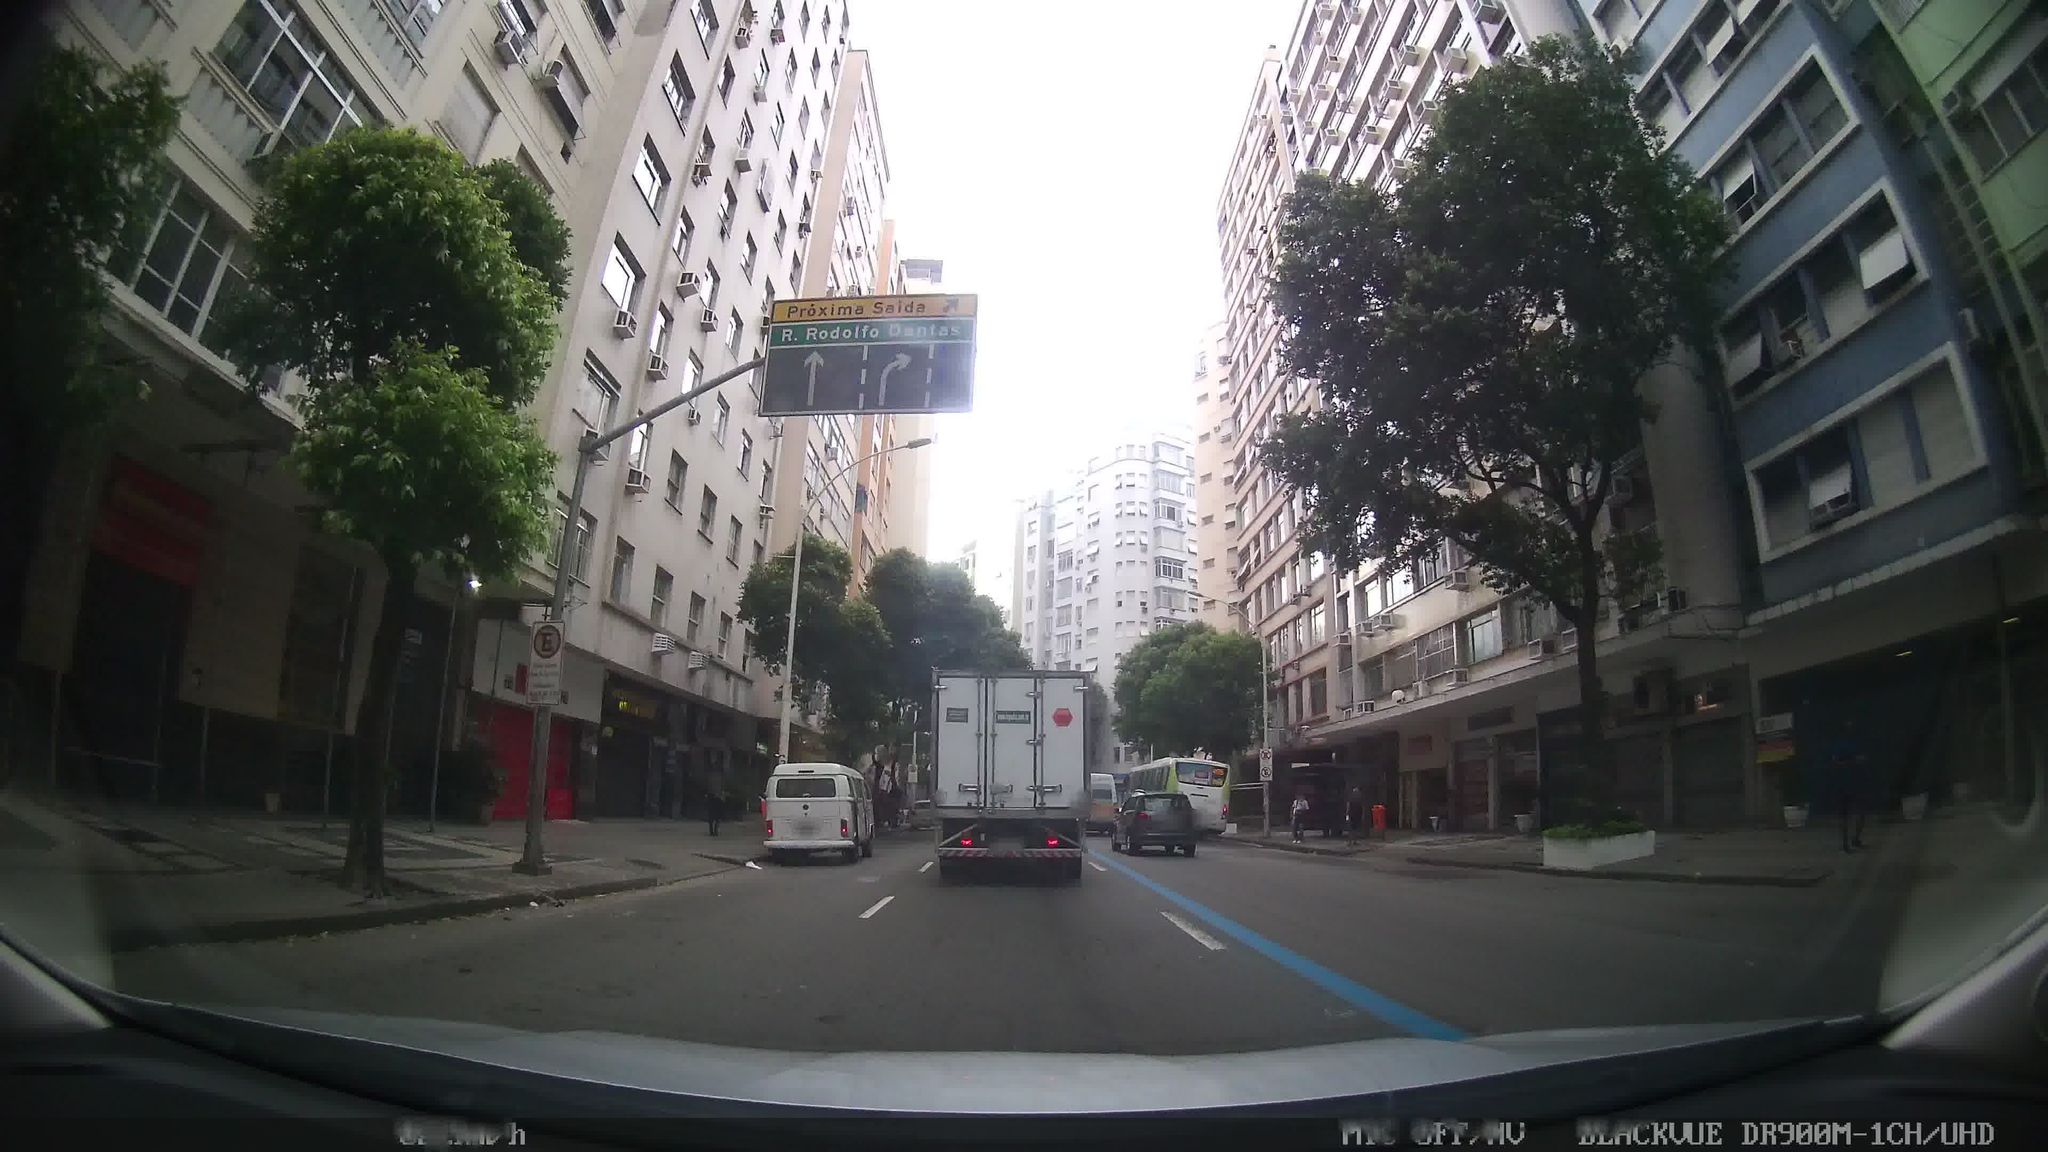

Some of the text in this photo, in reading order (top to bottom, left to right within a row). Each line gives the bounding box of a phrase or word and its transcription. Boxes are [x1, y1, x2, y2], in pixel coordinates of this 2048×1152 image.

[787, 303, 864, 318] Próxima
[781, 328, 798, 342] R.
[806, 325, 879, 340] Rodolfo
